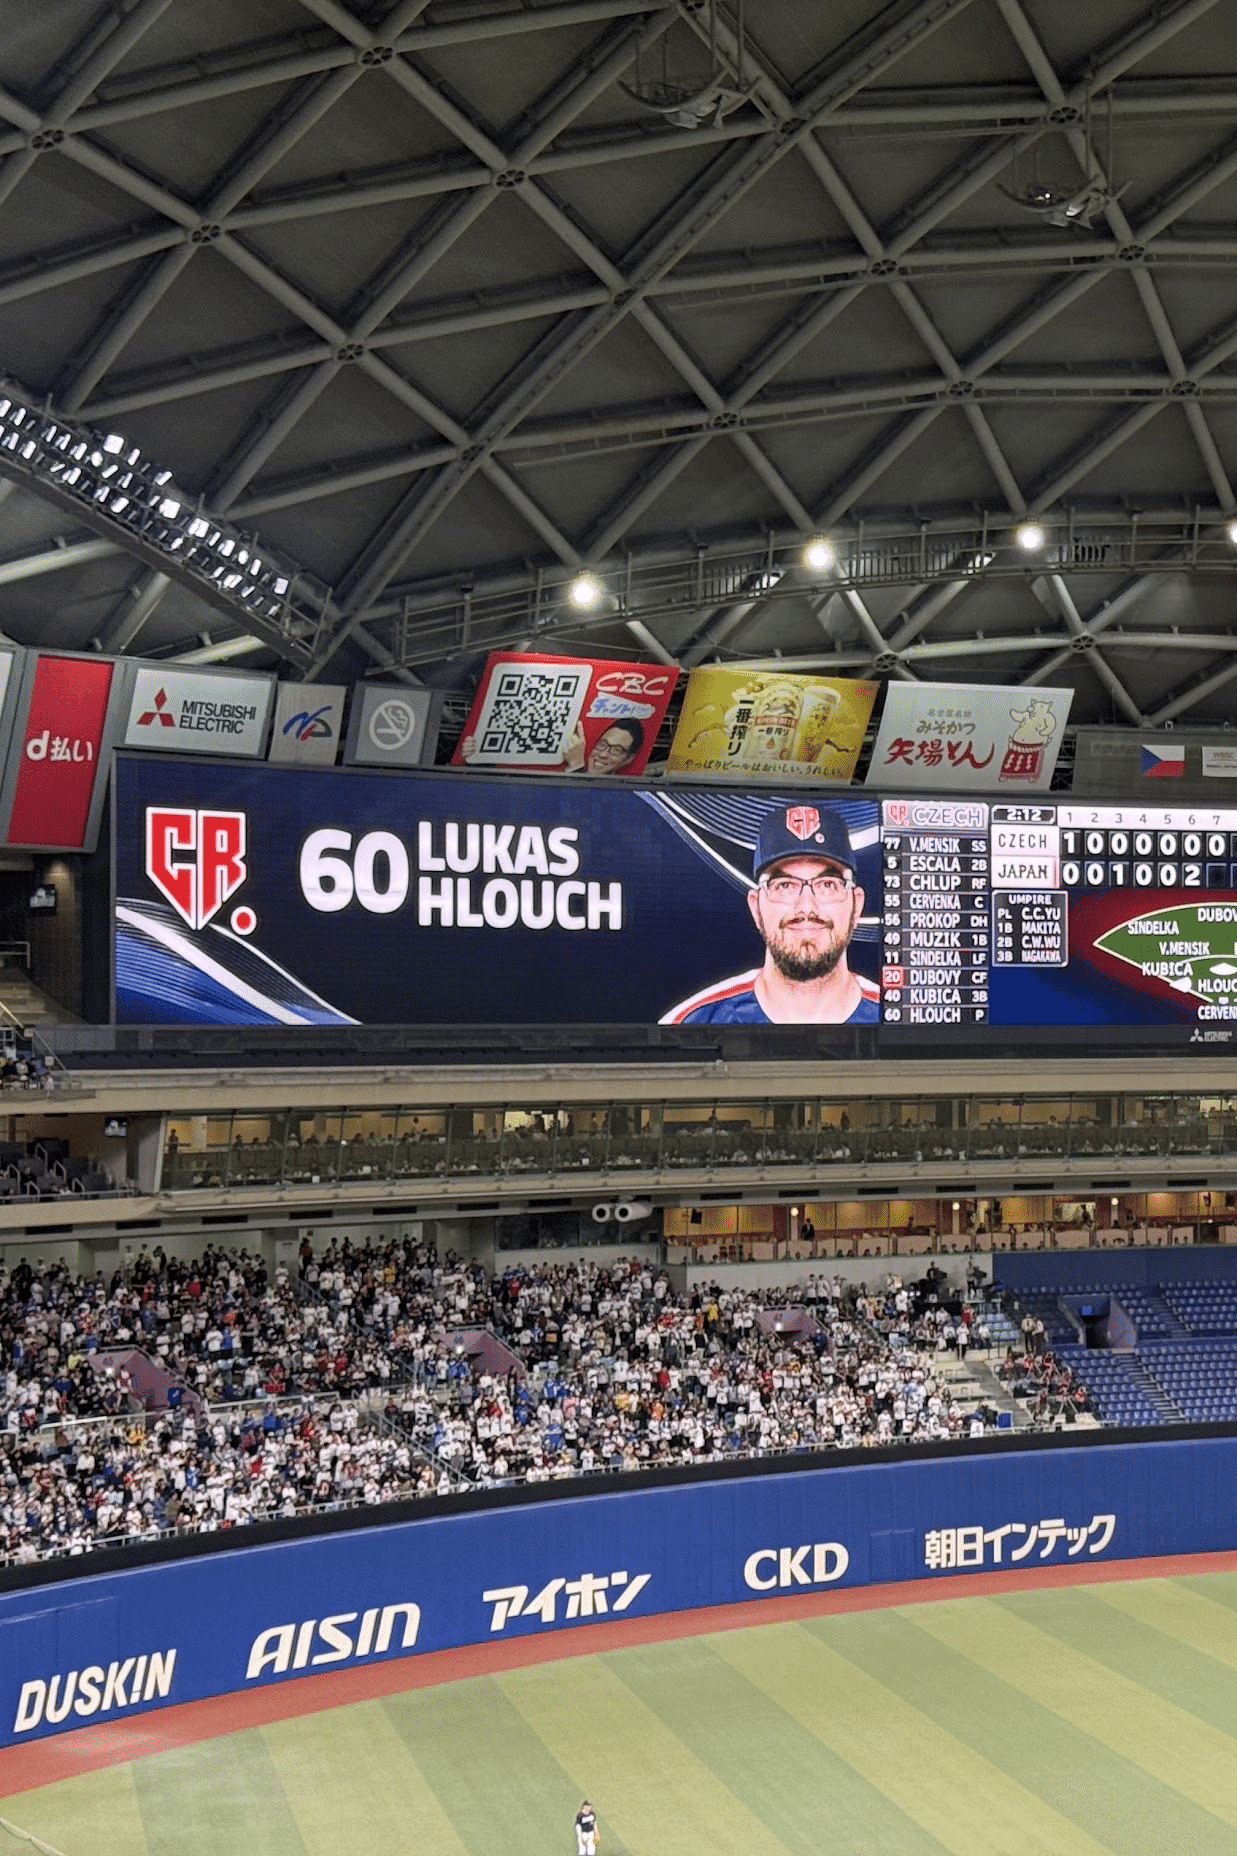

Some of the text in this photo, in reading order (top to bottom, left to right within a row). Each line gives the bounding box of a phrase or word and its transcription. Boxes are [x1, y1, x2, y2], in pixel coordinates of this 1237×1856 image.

[596, 672, 669, 696] CBC
[181, 700, 256, 720] MITSUBISHI
[179, 715, 245, 734] ELECTRIC
[728, 700, 755, 756] 一番搾り
[916, 720, 976, 735] みそかつ
[26, 730, 93, 762] d払い
[884, 737, 995, 769] 矢場とん
[913, 806, 983, 826] CZECH
[1007, 809, 1041, 821] 2:12
[418, 821, 580, 876] LUKAS
[884, 837, 986, 853] 77 V.MENSIK SS
[998, 834, 1047, 849] CZECH
[1063, 832, 1075, 854] 1
[1087, 833, 1104, 855] 0
[1111, 833, 1128, 855] 0
[1135, 833, 1152, 856] 0
[1160, 833, 1177, 856] 0
[1184, 834, 1201, 856] 0
[1209, 834, 1226, 857] 0
[300, 828, 409, 914] 60
[910, 856, 987, 871] ESCALA 2B
[998, 865, 1047, 879] JAPAN
[1063, 863, 1080, 885] 0
[1087, 863, 1104, 886] 0
[1113, 864, 1124, 885] 1
[1135, 864, 1152, 886] 0
[1160, 864, 1177, 886] 0
[1184, 864, 1201, 886] 2
[884, 875, 986, 890] 73 CHLUP RF
[418, 876, 622, 930] HLOUCH
[884, 894, 961, 909] 55 CERVENKA
[1008, 895, 1052, 905] UMPIRE
[884, 913, 987, 928] 56 PROKOP DH
[998, 908, 1061, 920] PL C.C.YU
[998, 922, 1061, 934] 1B MAKITA
[1128, 921, 1179, 935] SINDELKA
[884, 932, 987, 947] 49 MUZIK 1B
[997, 936, 1061, 949] 2B C.W.WU
[1159, 941, 1210, 955] V.MENSIK
[885, 951, 986, 966] 11 SINDELKA LF
[997, 951, 1013, 962] 3B
[1142, 962, 1193, 976] KUBICA
[885, 970, 987, 985] 20 DUBOVY CF
[884, 989, 987, 1004] 40 KUBICA 3B
[884, 1008, 961, 1023] 60 HLOUCH
[924, 1513, 1116, 1569] 朝日インテック
[743, 1542, 850, 1591] CKD
[482, 1571, 652, 1632] アイホン
[246, 1602, 421, 1680] AISIN
